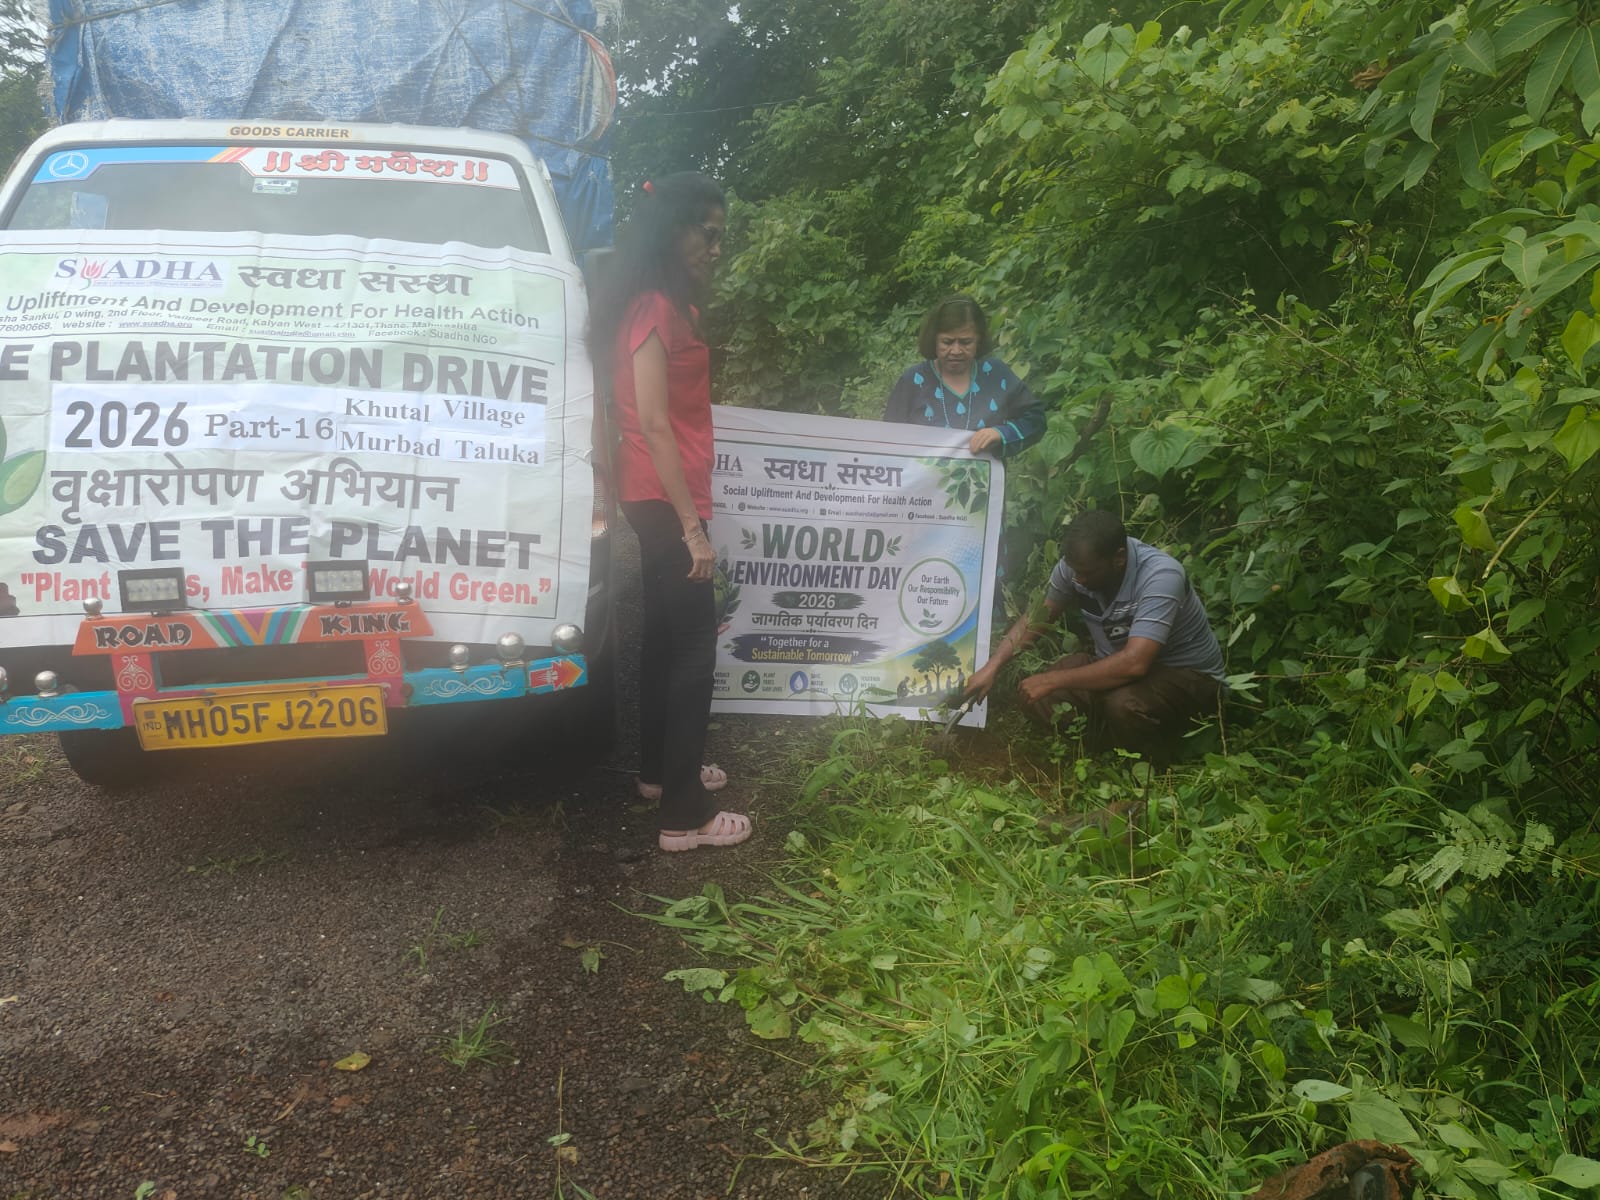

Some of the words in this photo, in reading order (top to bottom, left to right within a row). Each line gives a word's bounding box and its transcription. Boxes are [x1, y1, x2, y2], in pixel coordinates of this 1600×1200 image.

[230, 127, 281, 136] GOODS
[286, 128, 349, 138] CARRIER
[295, 150, 349, 171] श्री
[356, 151, 458, 177] गणेश
[238, 266, 346, 290] स्वधा
[358, 265, 473, 296] संस्था
[6, 291, 129, 314] Upliftment
[131, 296, 182, 311] And
[189, 298, 343, 319] Development
[350, 303, 388, 318] For
[394, 304, 463, 320] Health
[470, 306, 539, 329] Action
[63, 310, 72, 318] D
[107, 309, 128, 317] 2nd
[252, 318, 290, 329] Kalyan
[294, 320, 321, 328] West
[63, 320, 105, 328] website
[206, 323, 238, 332] Email
[368, 328, 419, 337] Facebook
[430, 329, 469, 342] Suadha
[473, 335, 497, 345] NGO
[50, 341, 383, 388] PLANTATION
[403, 352, 548, 405] DRIVE
[65, 401, 189, 448] 2026
[204, 414, 334, 440] Part-16
[344, 398, 429, 423] Khutal
[443, 400, 526, 429] Village
[340, 431, 440, 457] Murbad
[456, 439, 539, 465] Taluka
[764, 457, 827, 482] स्वधा
[837, 457, 904, 487] संस्था
[51, 452, 264, 524] वृक्षारोपण
[280, 456, 460, 512] अभियान
[723, 485, 748, 497] Social
[751, 486, 793, 500] Upliftment
[795, 490, 812, 500] And
[814, 491, 865, 505] Development
[868, 495, 880, 504] For
[883, 495, 906, 506] Health
[909, 496, 932, 506] Action
[32, 521, 180, 565] SAVE
[201, 518, 310, 559] THE
[329, 520, 541, 570] PLANET
[762, 523, 885, 563] WORLD
[222, 564, 293, 595] Make
[734, 560, 864, 589] ENVIRONMENT
[867, 566, 902, 590] DAY
[933, 575, 950, 585] Earth
[798, 594, 836, 609] 2026
[95, 622, 192, 649] ROAD
[319, 611, 411, 637] KING
[752, 610, 803, 627] जागतिक
[806, 611, 854, 628] पर्यावरण
[857, 612, 879, 629] दिन
[752, 648, 804, 661] Sustainable
[809, 637, 822, 648] for
[824, 640, 830, 649] a
